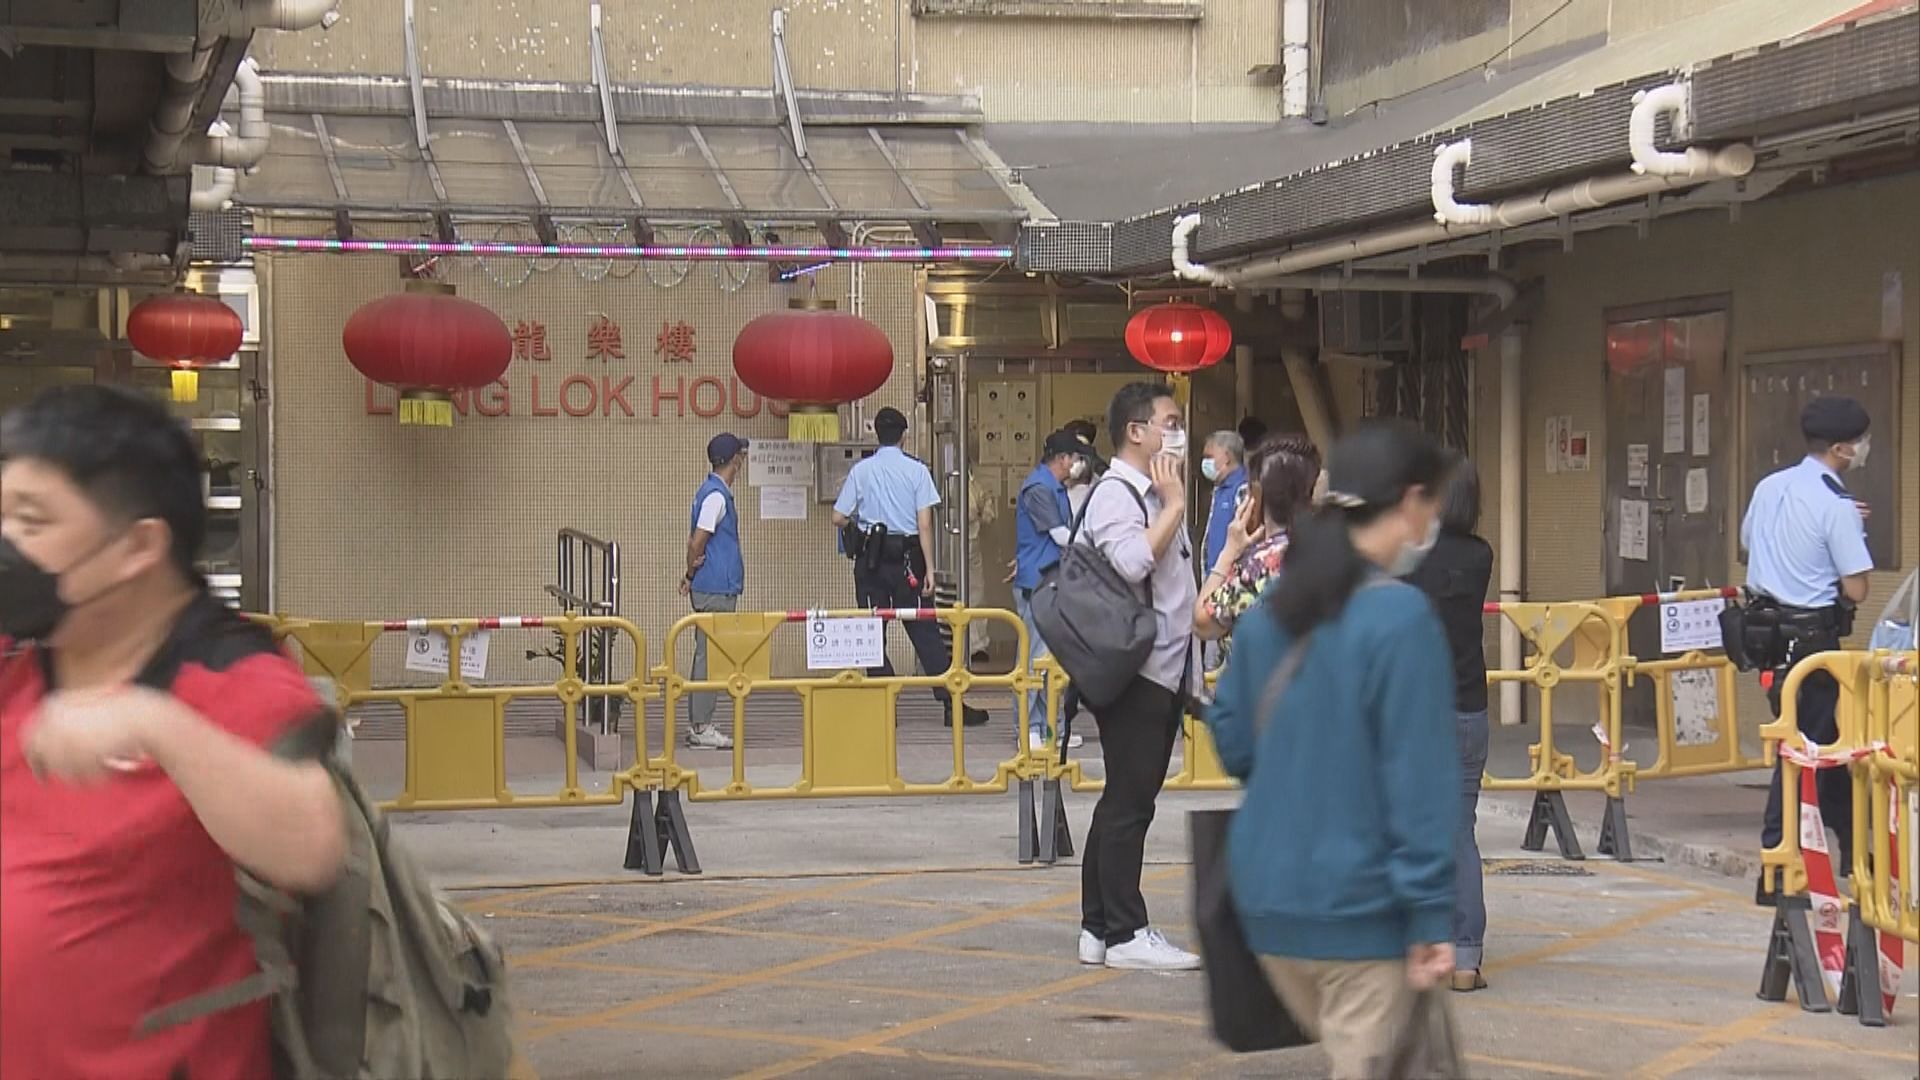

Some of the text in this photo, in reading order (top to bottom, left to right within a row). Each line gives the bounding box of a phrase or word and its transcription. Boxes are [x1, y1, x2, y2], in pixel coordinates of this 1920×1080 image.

[512, 317, 697, 364] 龍樂樓
[366, 375, 510, 417] LNG
[531, 373, 636, 417] LOK
